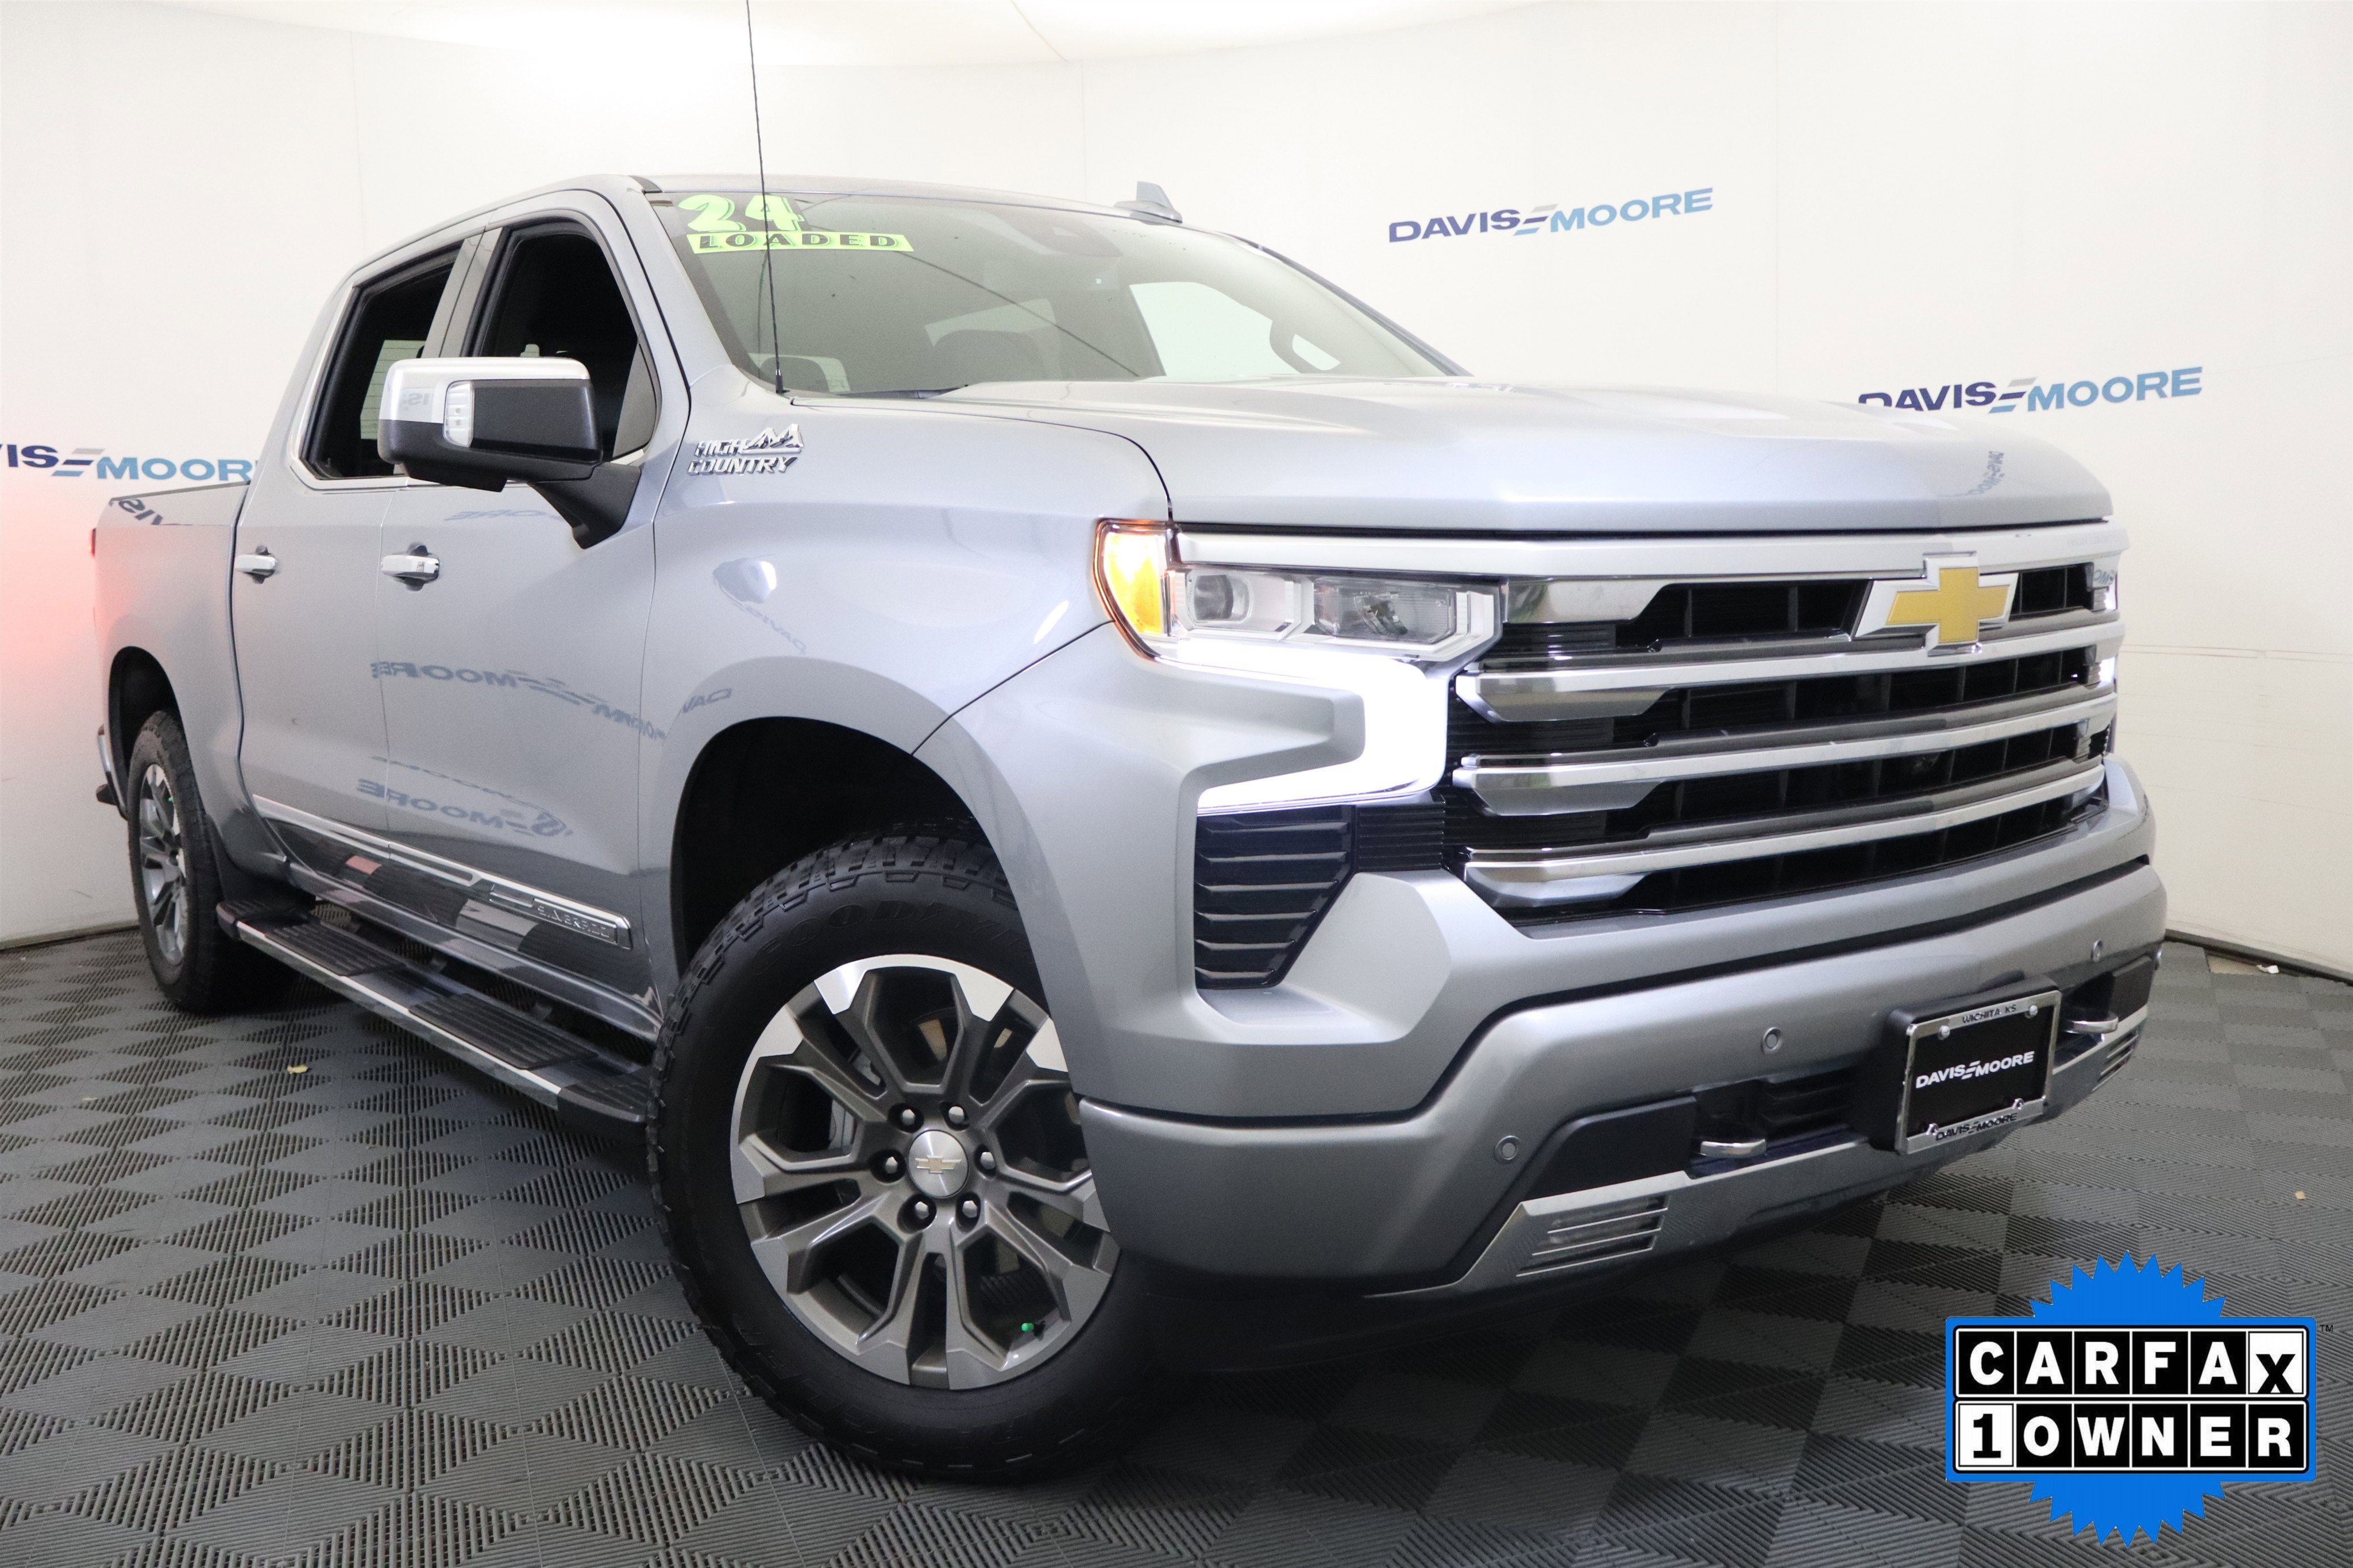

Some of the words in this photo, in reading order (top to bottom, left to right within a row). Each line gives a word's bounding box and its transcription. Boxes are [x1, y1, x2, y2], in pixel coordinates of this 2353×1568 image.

[678, 194, 804, 231] 24
[1389, 209, 1521, 242] DAVIS
[1550, 187, 1714, 233] MOORE
[698, 233, 899, 250] LOADED
[2027, 366, 2203, 412] MOORE
[0, 444, 59, 469] IS
[96, 457, 258, 481] MOOR
[694, 439, 749, 457] HIGH
[687, 457, 799, 476] COUNTRY
[2005, 1004, 2017, 1014] KS
[1915, 1064, 1966, 1088] DAVIS
[1975, 1051, 2035, 1077] MOORE
[1935, 1124, 1970, 1141] DAVIS
[1976, 1113, 2018, 1131] MOORE
